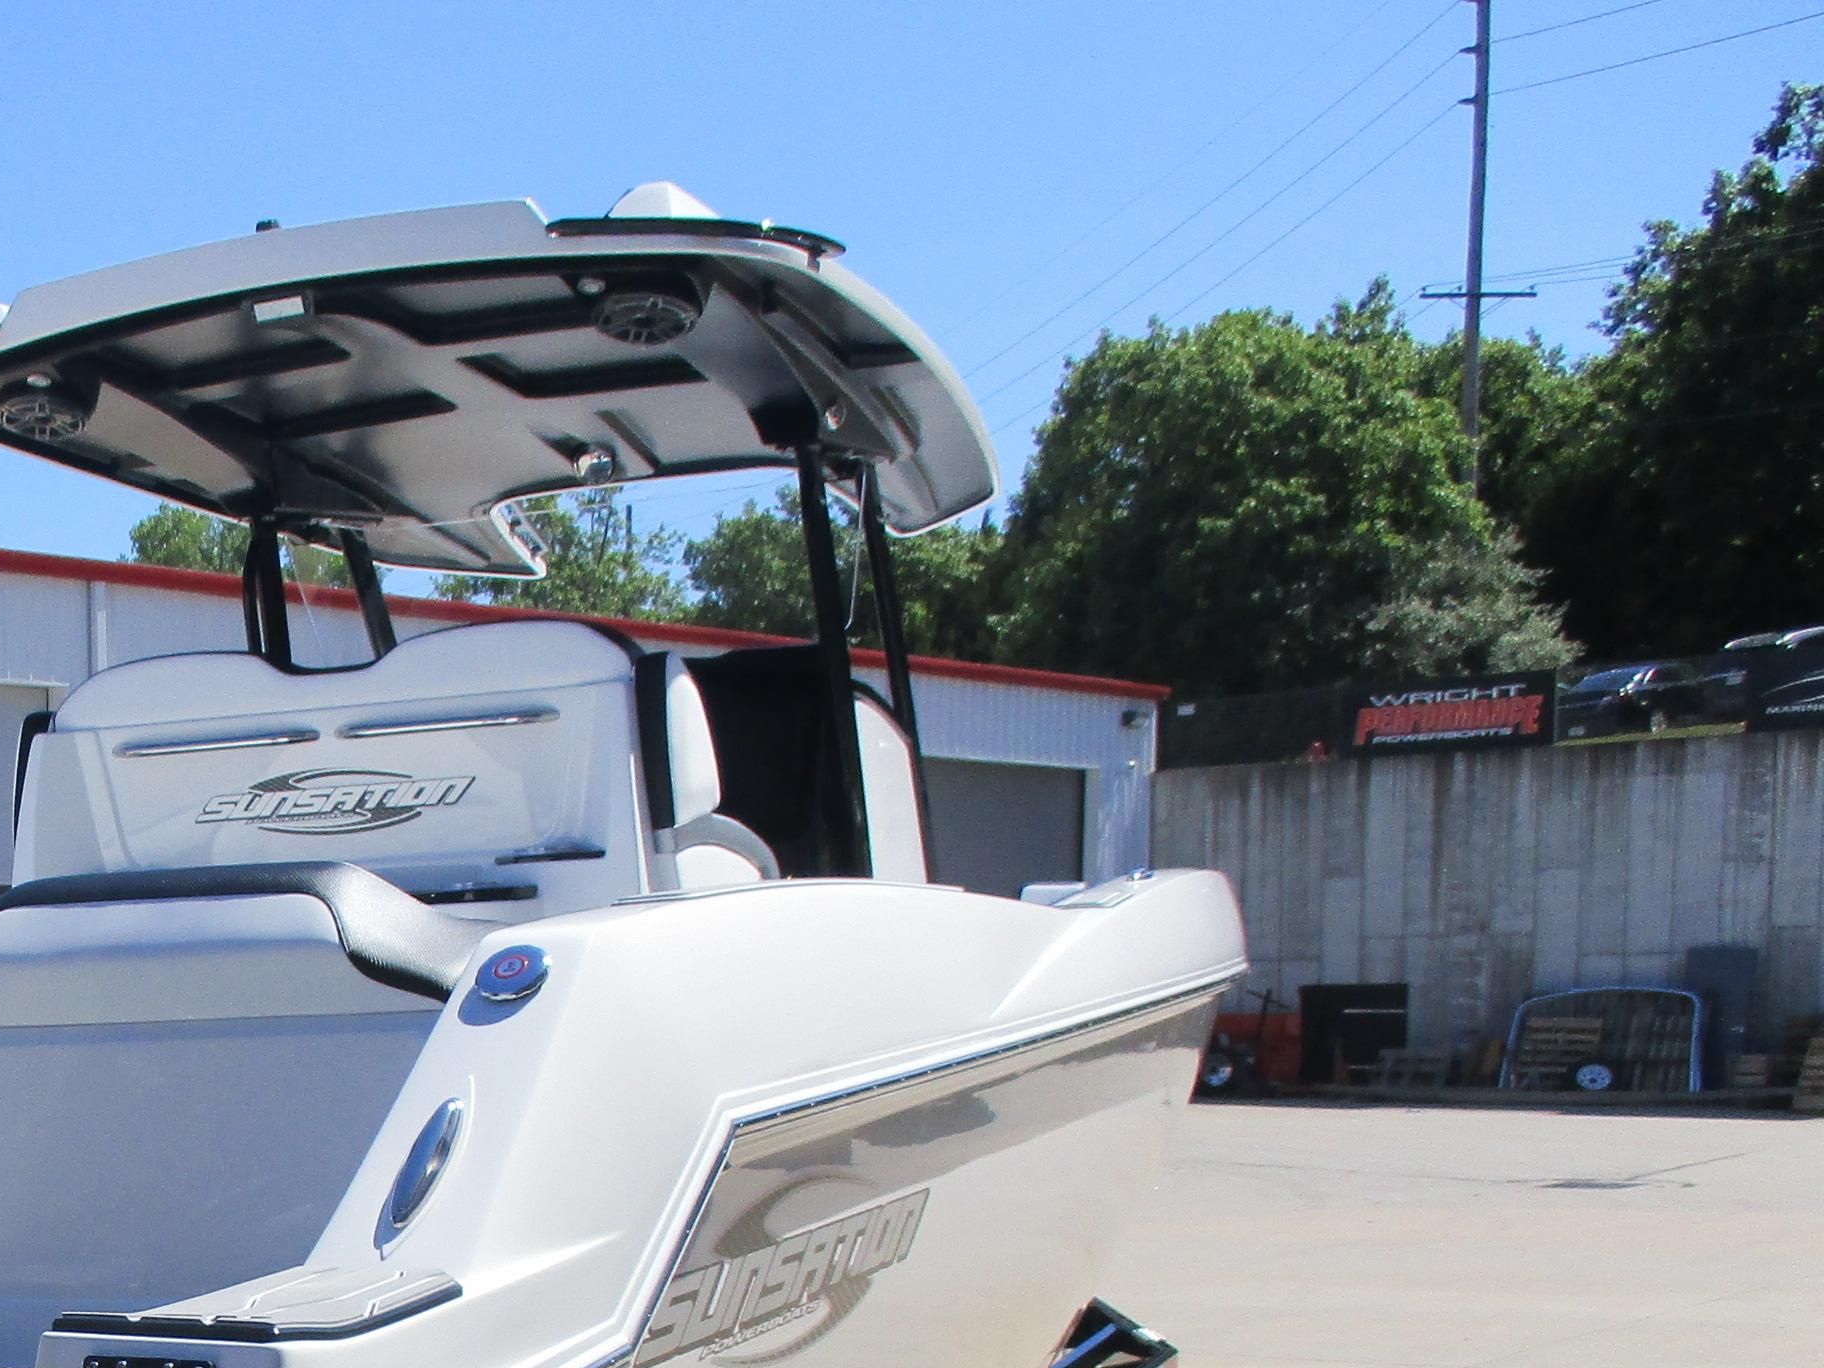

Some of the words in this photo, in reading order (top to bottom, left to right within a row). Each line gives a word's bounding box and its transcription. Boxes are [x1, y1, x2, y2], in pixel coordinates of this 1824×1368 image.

[1369, 683, 1527, 707] WRIGHT
[195, 775, 476, 824] SUNSATION
[698, 1300, 825, 1362] POWERBOATS
